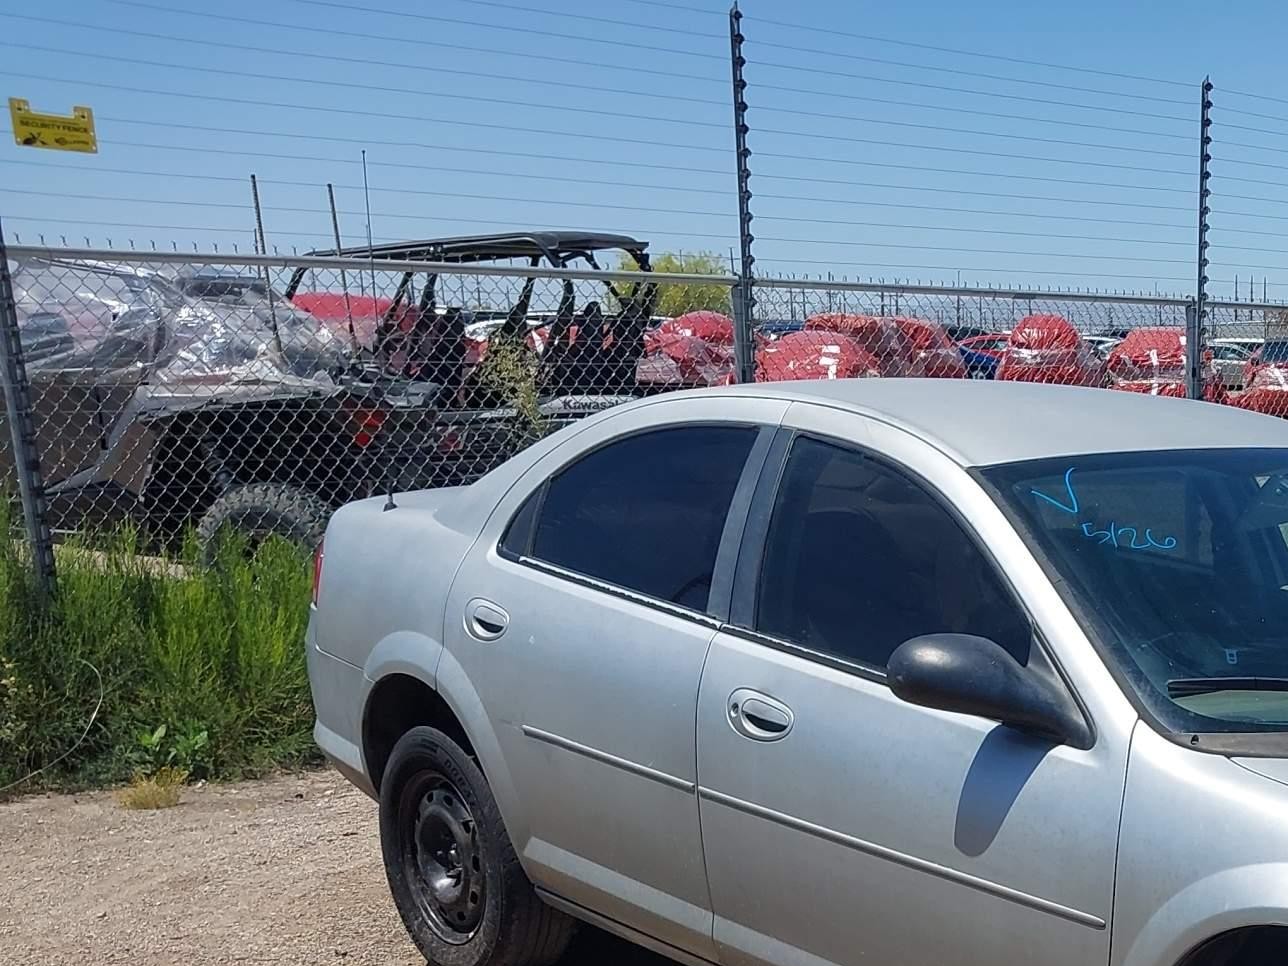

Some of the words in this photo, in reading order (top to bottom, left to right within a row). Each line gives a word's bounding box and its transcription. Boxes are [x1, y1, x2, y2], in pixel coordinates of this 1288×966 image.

[19, 119, 61, 131] SECURITY
[62, 125, 89, 134] FENCE
[1081, 521, 1177, 550] 5/26
